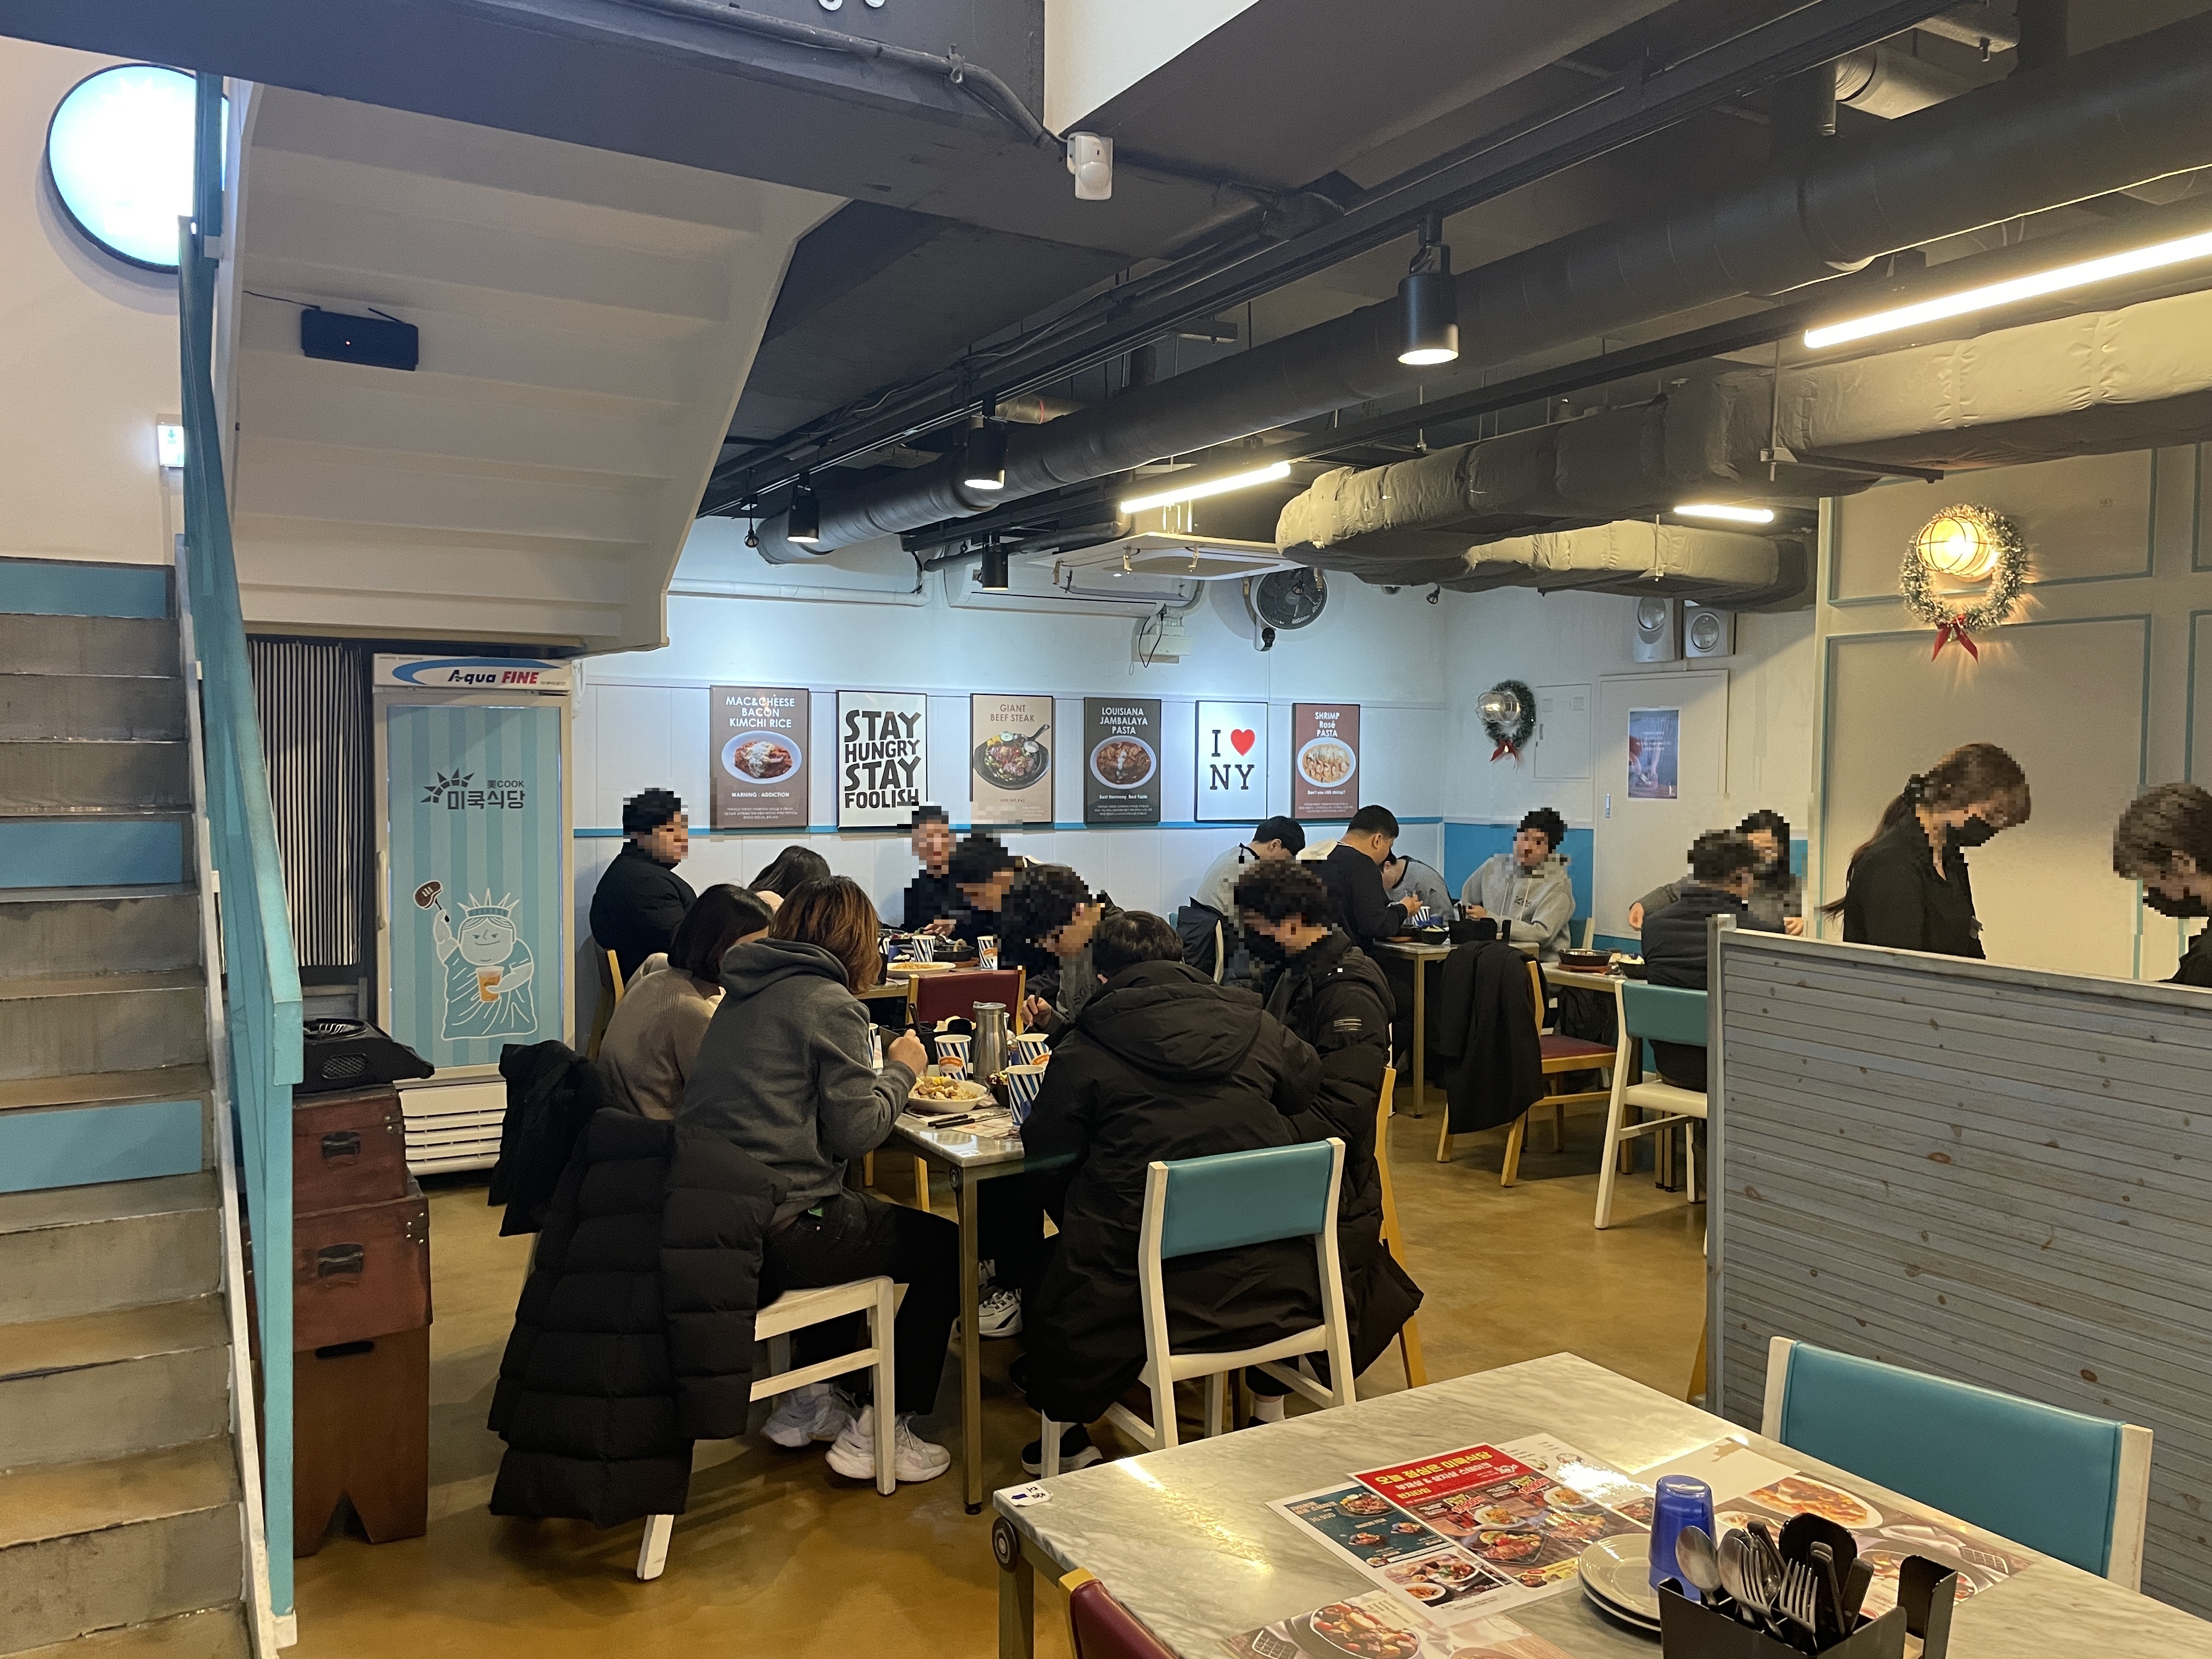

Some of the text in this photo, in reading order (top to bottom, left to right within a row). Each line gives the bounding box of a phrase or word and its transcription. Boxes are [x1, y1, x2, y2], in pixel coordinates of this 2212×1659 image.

[448, 670, 539, 684] Aqua FINE
[726, 697, 795, 707] MAC&CHEESE
[742, 708, 780, 717] BACON
[1000, 704, 1026, 712] GIANT
[1102, 707, 1144, 716] LOUISIANA
[1099, 716, 1148, 725] JAMBALAYA
[1314, 712, 1340, 720] SHRIMP
[730, 718, 792, 728] KIMCHI RICE
[844, 709, 922, 742] STAY
[1319, 720, 1336, 729] Rosé
[1112, 726, 1136, 735] PASTA
[1317, 729, 1338, 737] PASTA
[1211, 729, 1221, 757] I
[845, 739, 921, 763] HUNGRY
[844, 755, 922, 791] STAY
[1210, 764, 1255, 790] NY
[448, 790, 526, 810] 미쿡식당
[844, 788, 919, 809] FOOLISH
